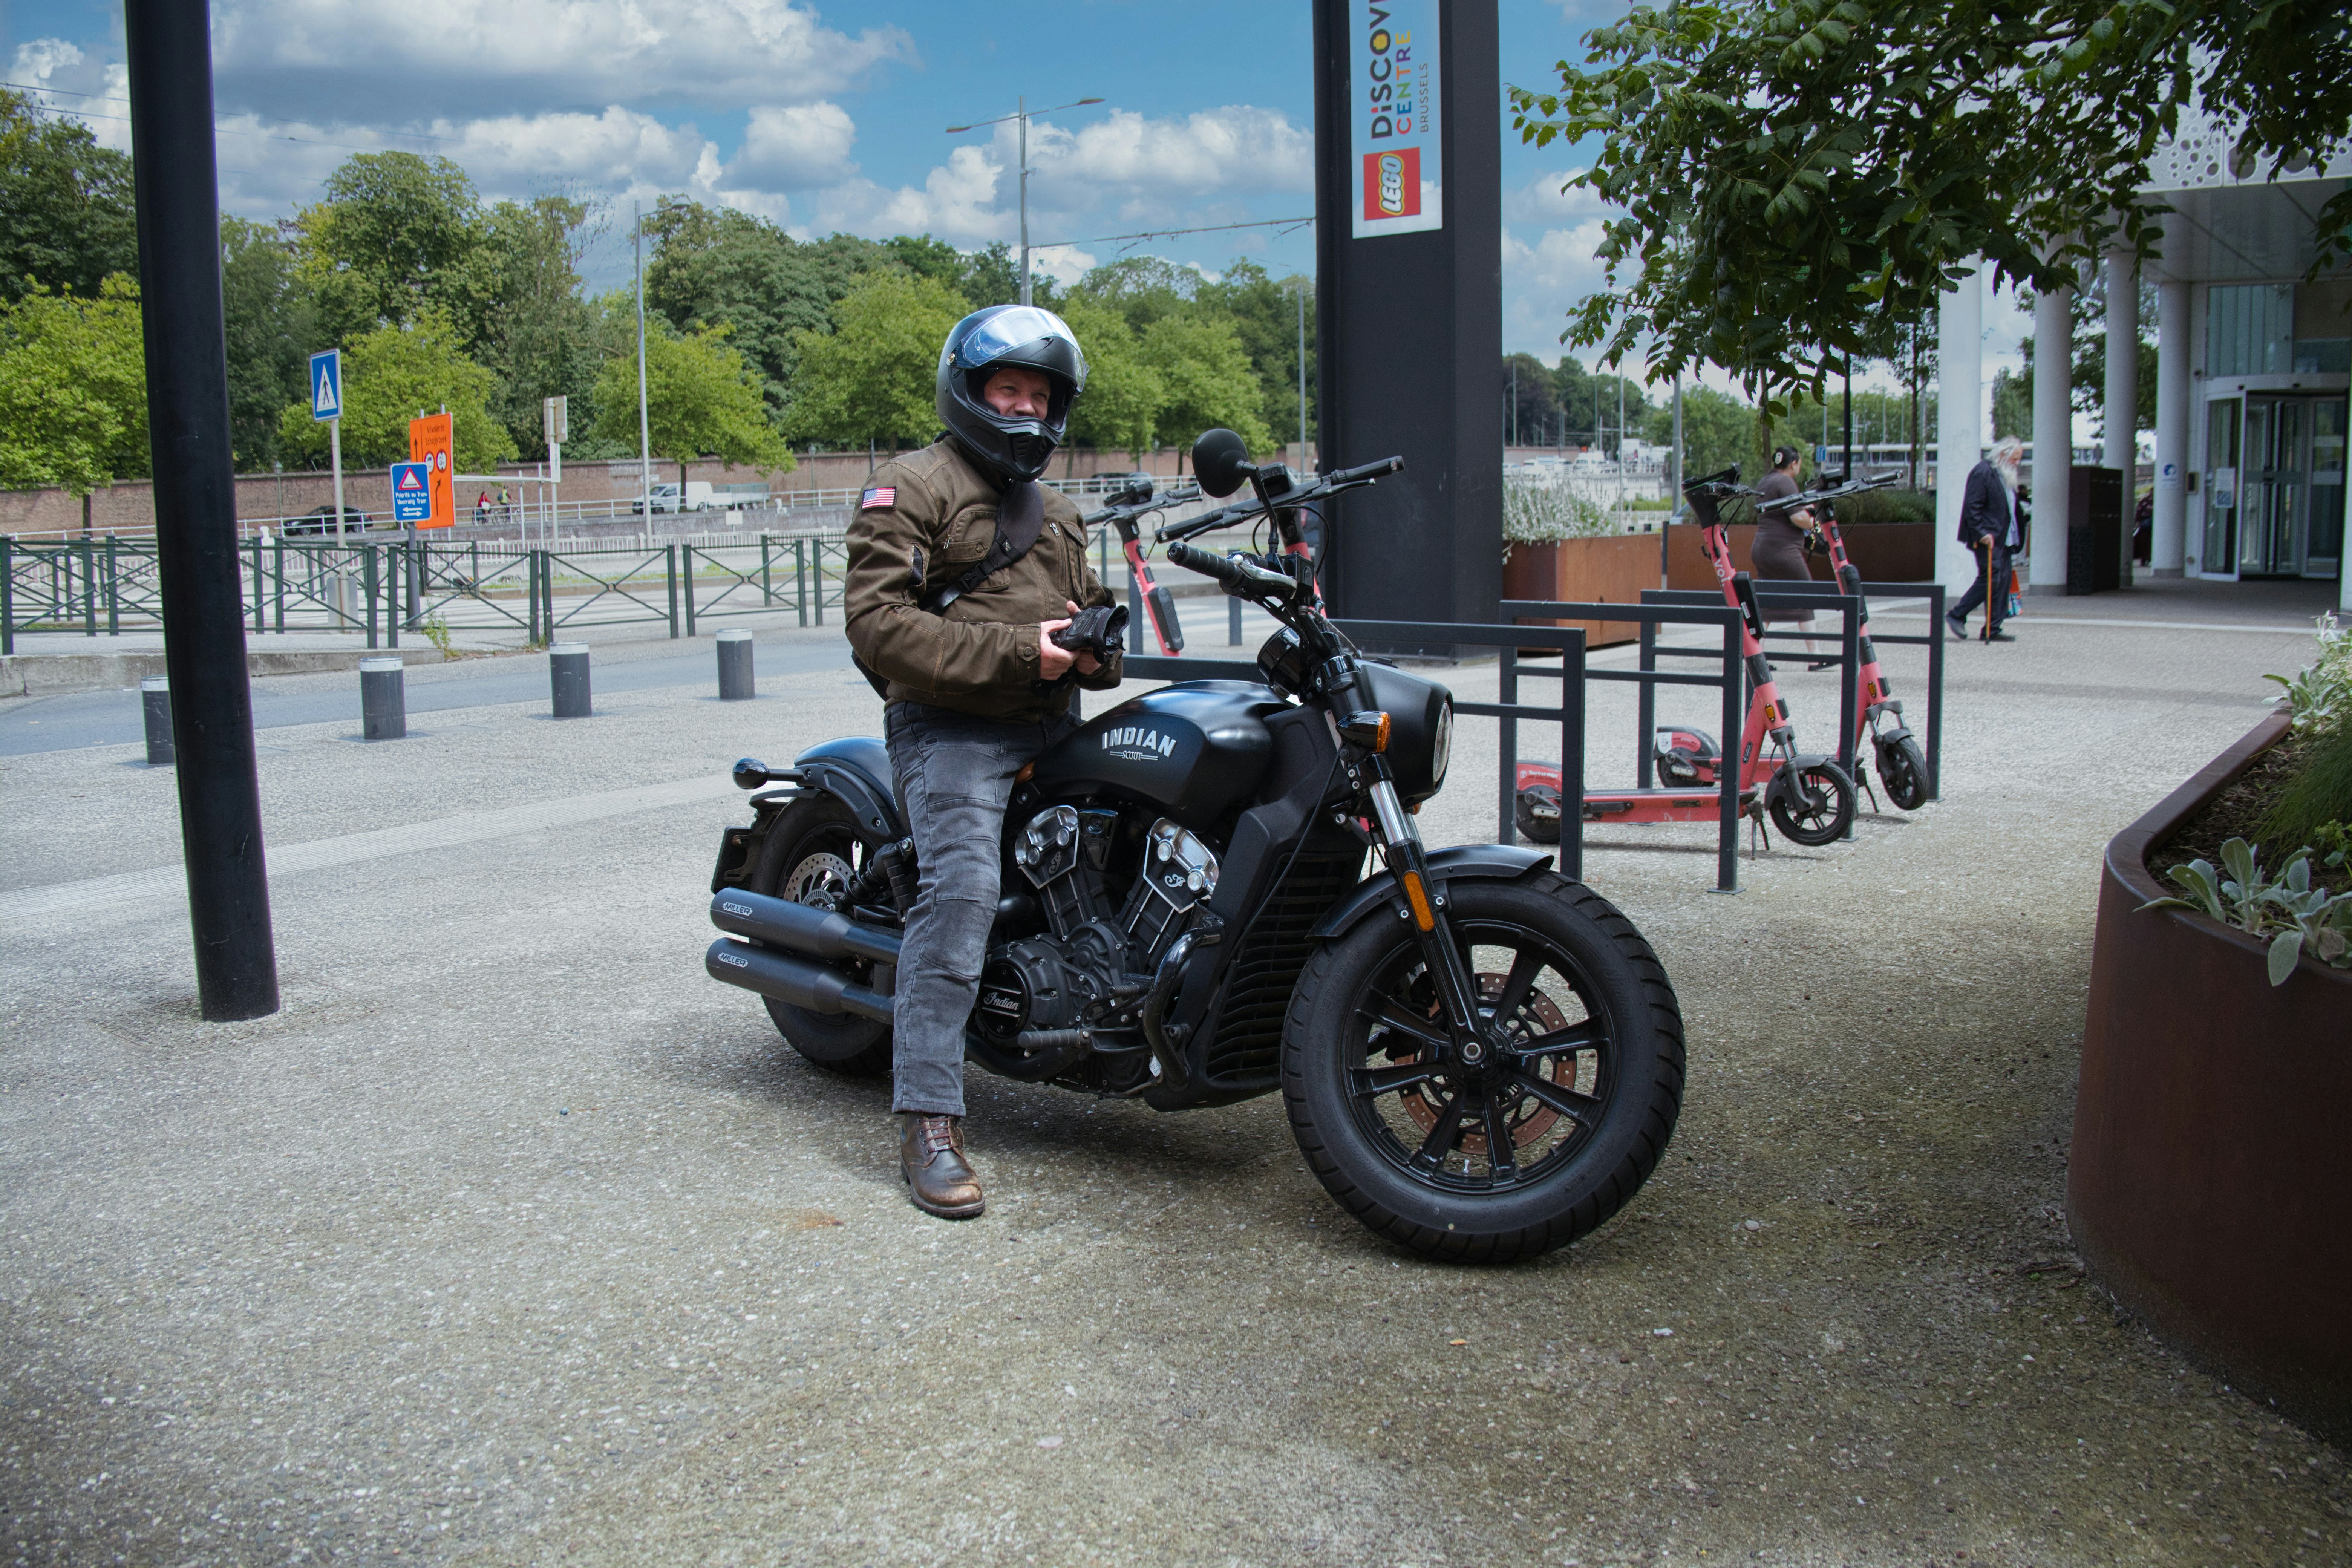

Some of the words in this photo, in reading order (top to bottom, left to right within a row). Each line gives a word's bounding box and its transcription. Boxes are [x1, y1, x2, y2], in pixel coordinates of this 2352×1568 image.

[1369, 0, 1392, 139] DiSCOV
[1396, 31, 1412, 135] CENTRE
[1419, 63, 1429, 132] BRUSSELS
[1380, 154, 1404, 214] LEGO
[1102, 727, 1177, 758] INDIAN
[1122, 750, 1143, 761] SCOUT
[724, 902, 751, 916] MILLER
[720, 953, 747, 967] MILLER
[983, 992, 1019, 1011] Indian
